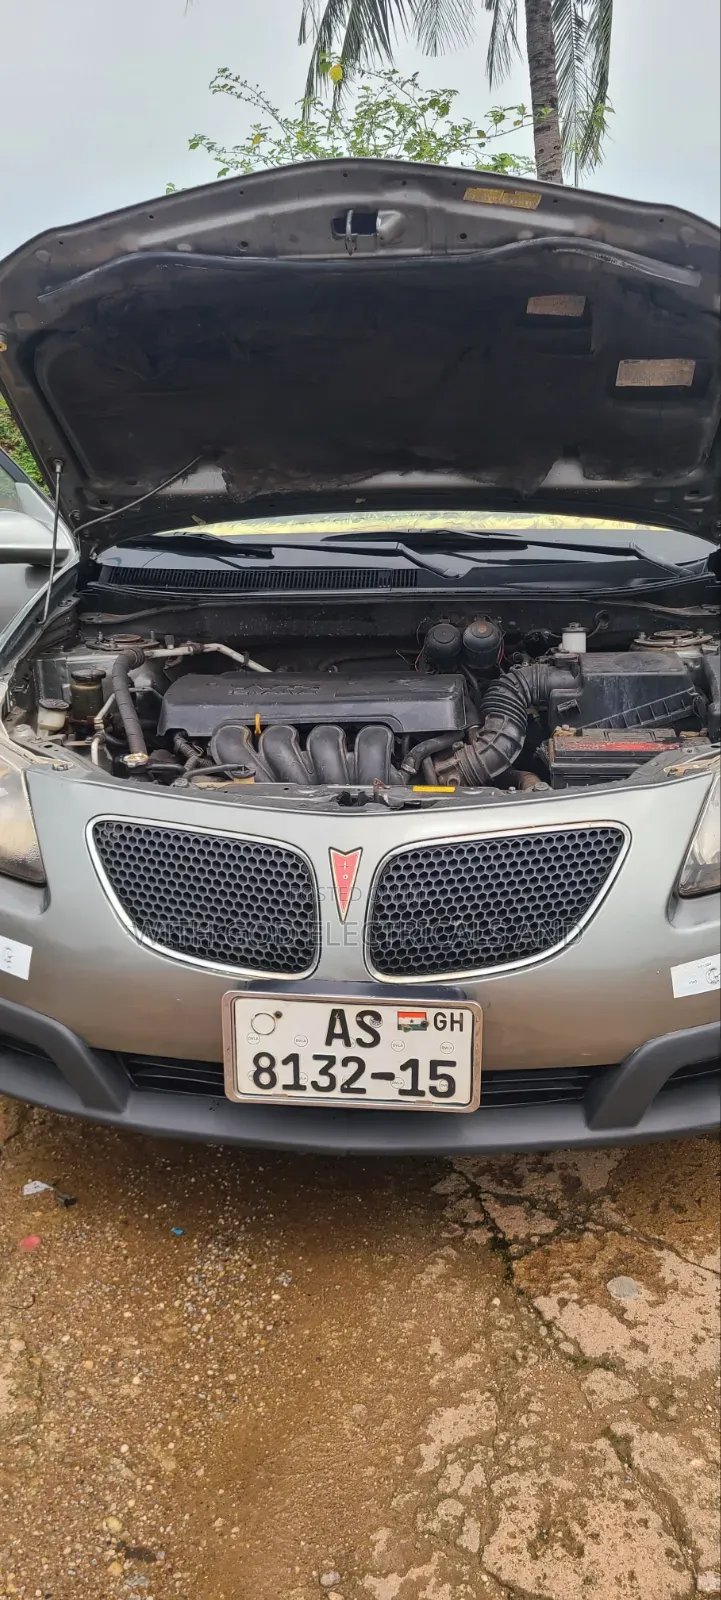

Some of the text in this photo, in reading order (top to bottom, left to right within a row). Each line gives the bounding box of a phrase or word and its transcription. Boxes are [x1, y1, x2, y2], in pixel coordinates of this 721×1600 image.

[325, 1008, 382, 1048] AS
[433, 1011, 464, 1033] GH
[252, 1051, 457, 1099] 8132-15
